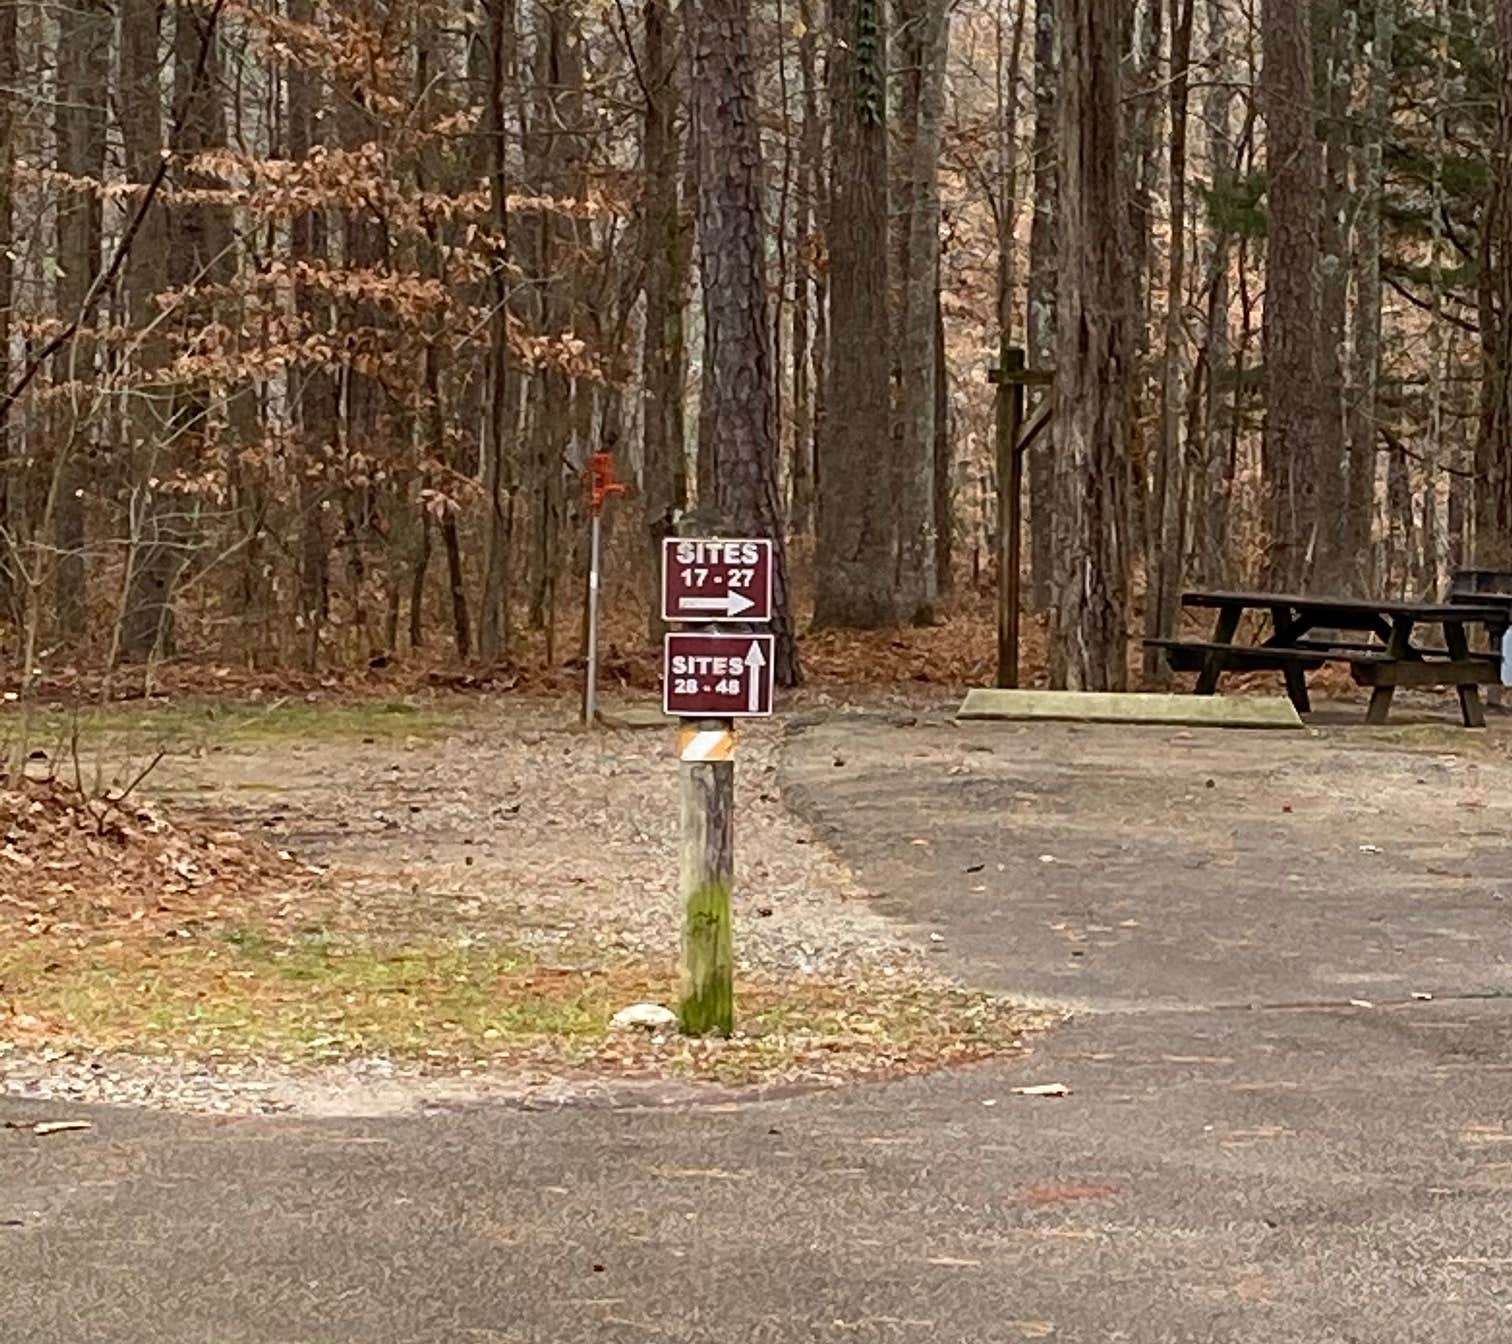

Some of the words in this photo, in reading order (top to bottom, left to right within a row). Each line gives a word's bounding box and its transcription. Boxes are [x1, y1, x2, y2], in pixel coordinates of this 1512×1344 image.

[676, 542, 759, 565] SITES
[680, 568, 709, 588] 17
[727, 568, 755, 588] 27
[671, 655, 744, 676] SITES
[674, 679, 698, 694] 28
[715, 679, 741, 695] 48
